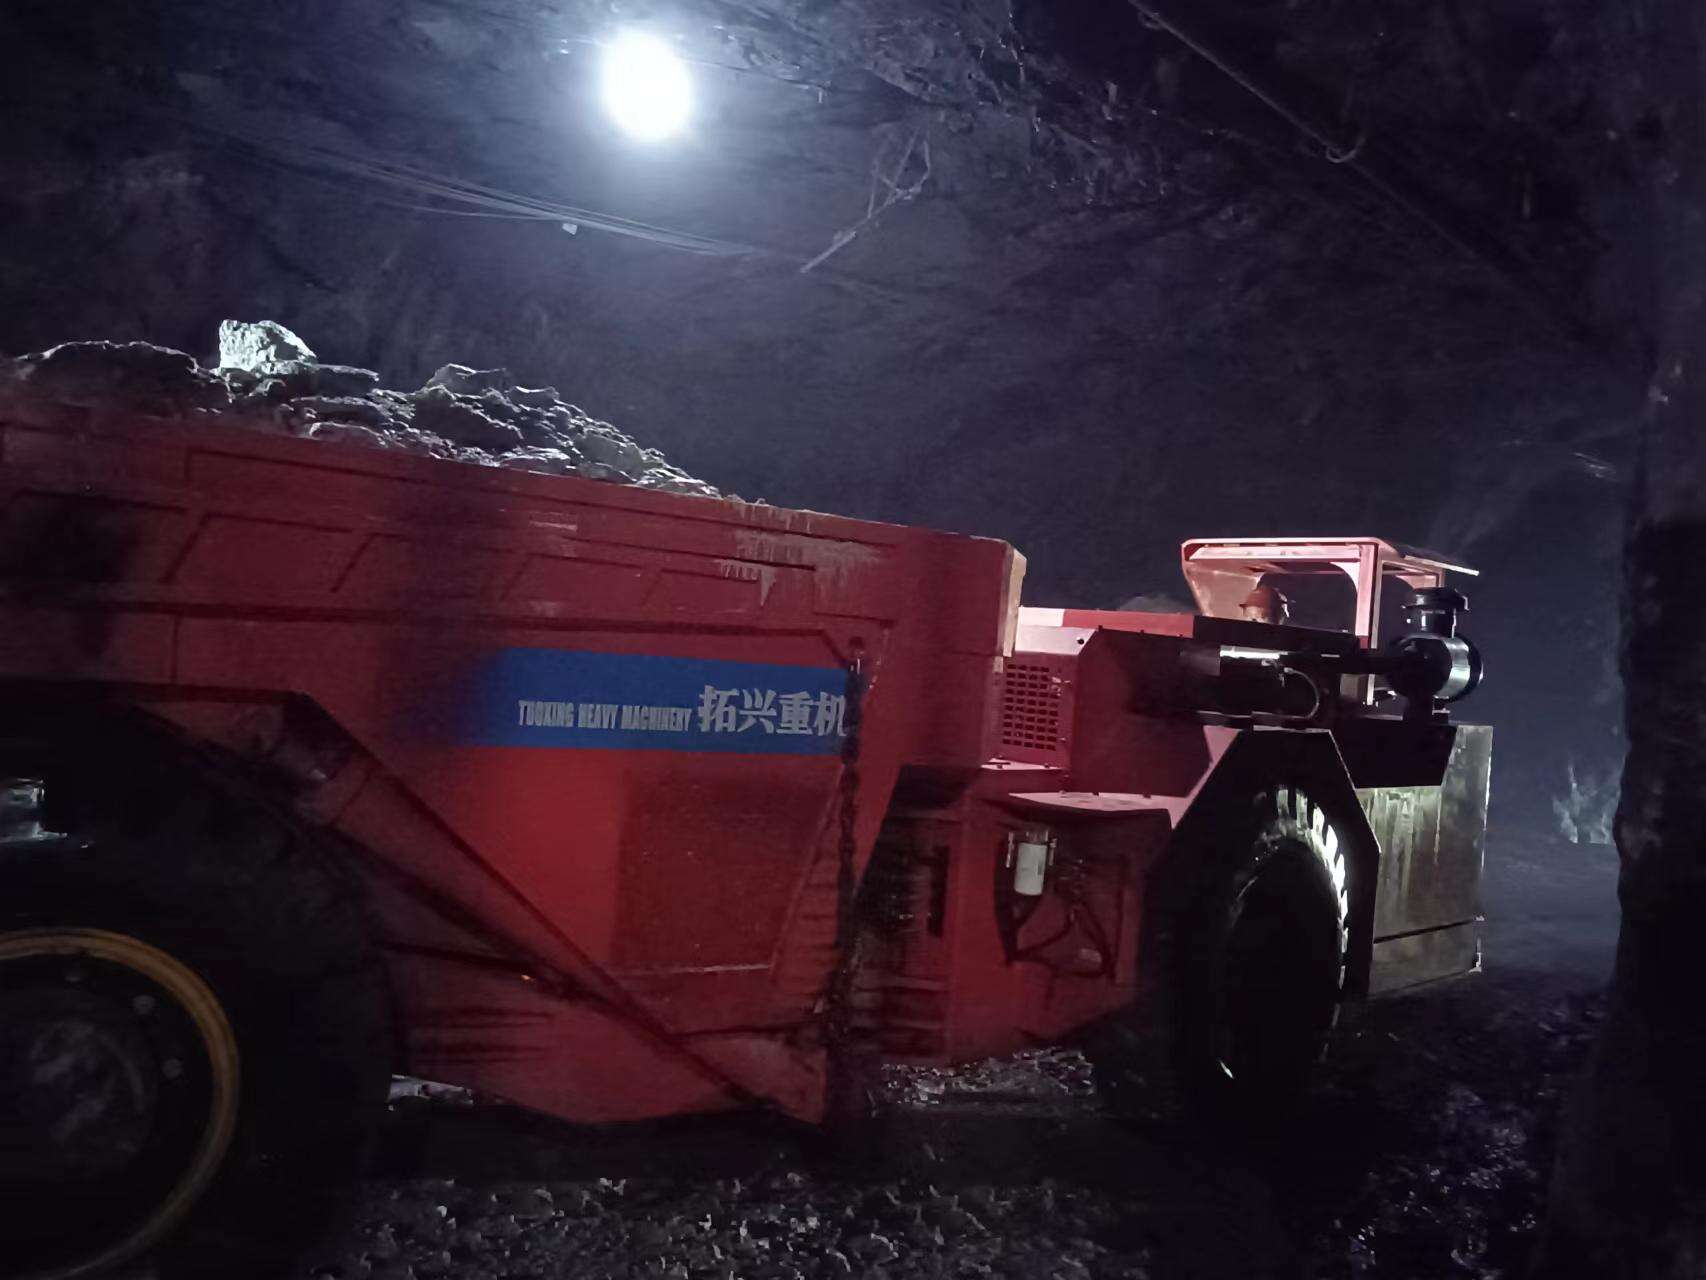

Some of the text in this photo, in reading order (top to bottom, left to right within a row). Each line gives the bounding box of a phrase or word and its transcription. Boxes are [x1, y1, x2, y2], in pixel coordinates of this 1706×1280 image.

[578, 703, 619, 730] HEAVY
[621, 706, 693, 732] MACHINERY
[698, 685, 847, 737] 拓兴重机
